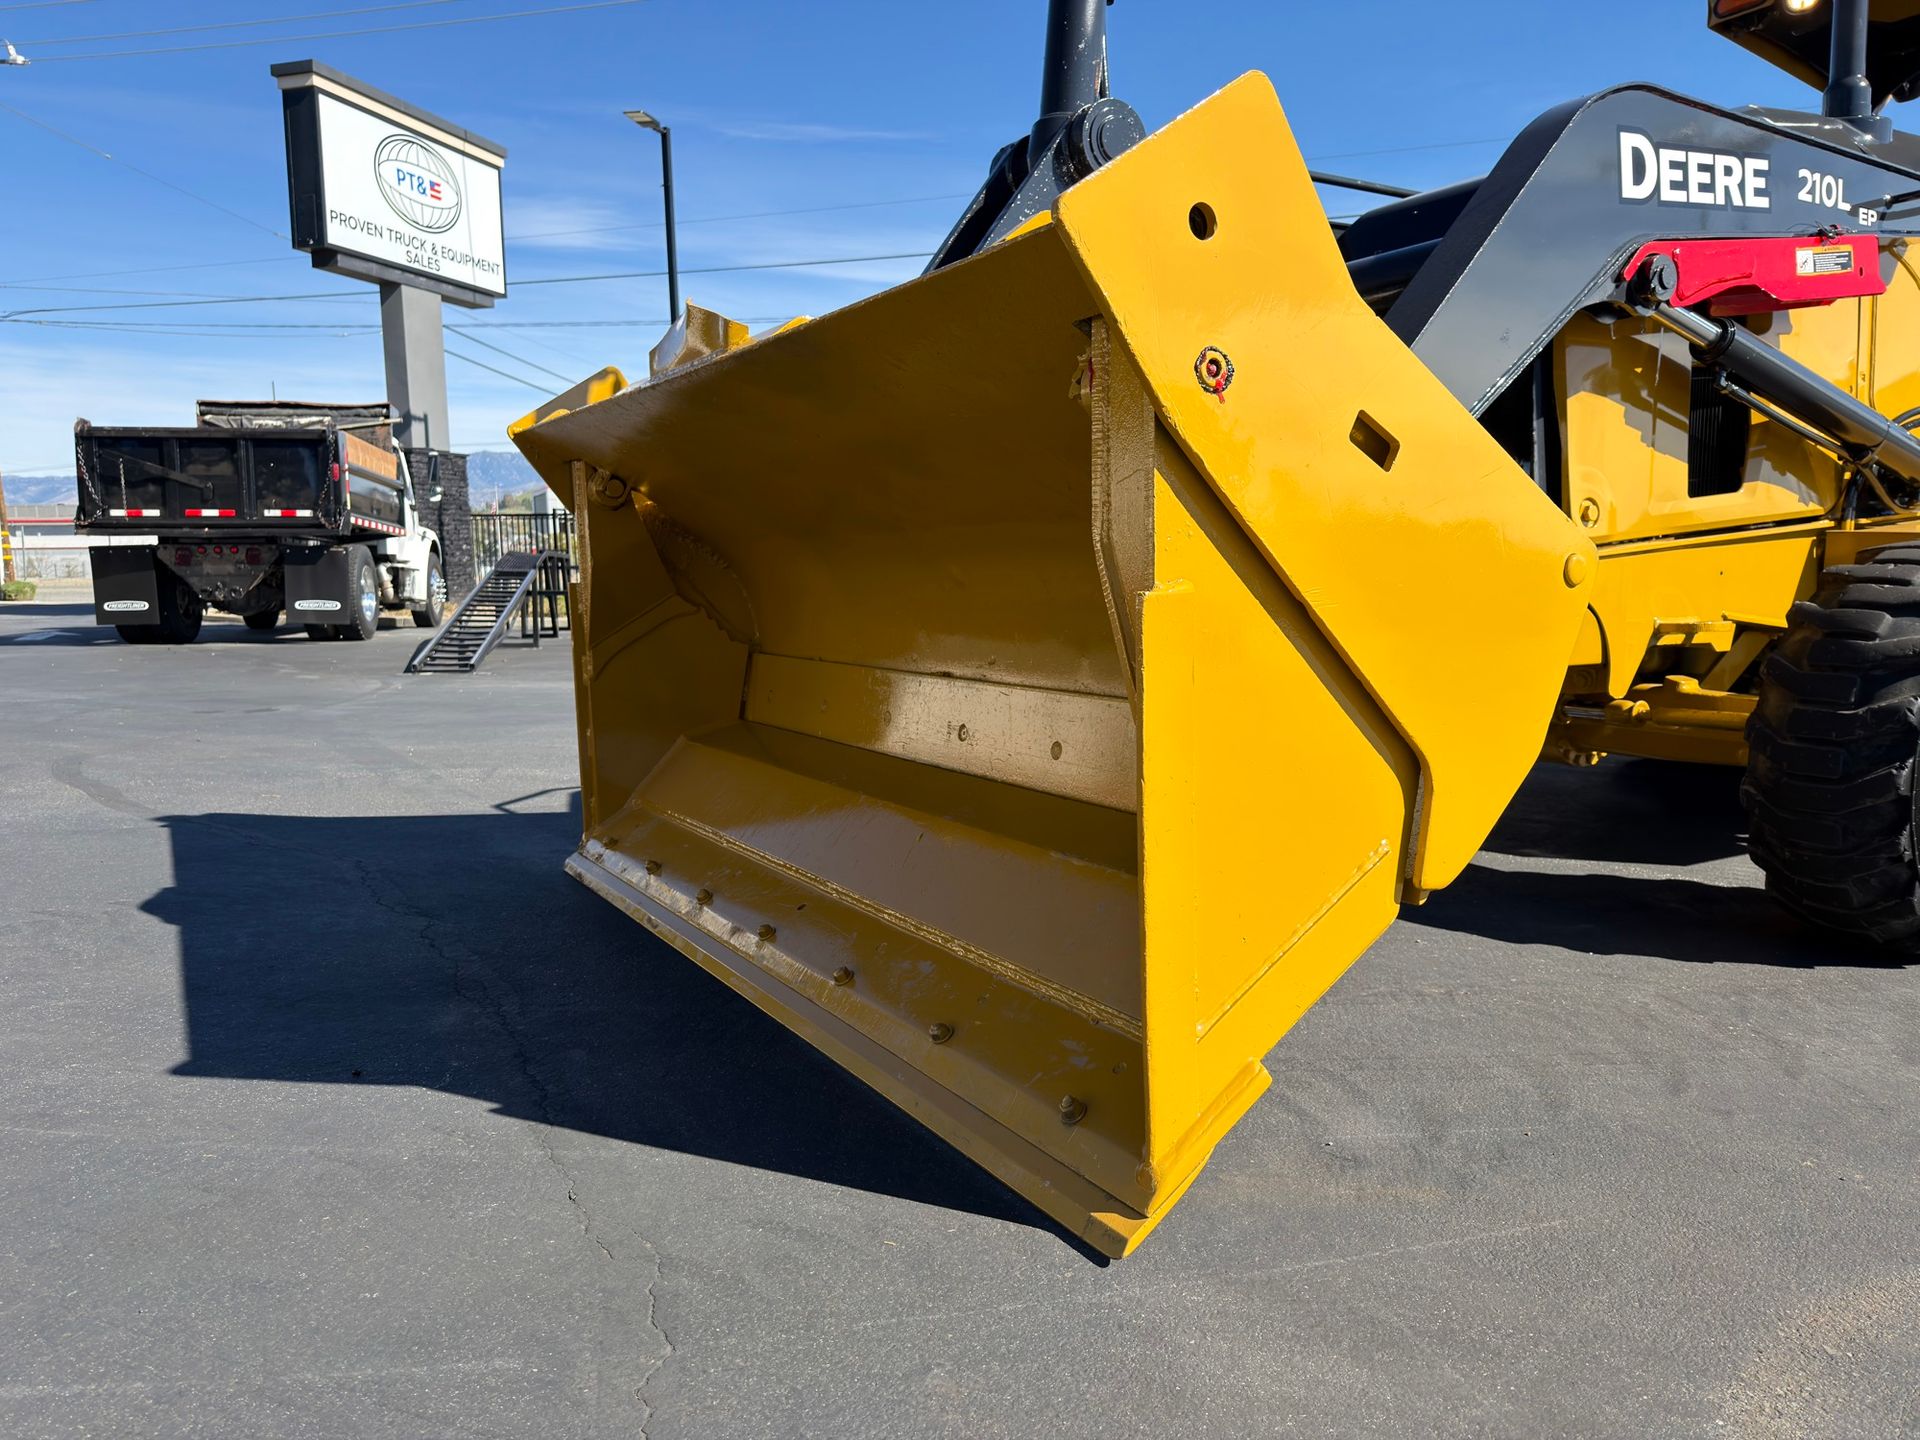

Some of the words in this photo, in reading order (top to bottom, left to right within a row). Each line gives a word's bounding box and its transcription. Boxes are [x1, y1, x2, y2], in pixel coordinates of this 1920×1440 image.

[1619, 131, 1770, 208] DEERE
[1797, 168, 1851, 211] 210L
[1858, 207, 1877, 226] EP
[329, 209, 384, 239] PROVEN
[386, 227, 428, 253] TRUCK
[431, 242, 439, 256] &
[441, 246, 500, 276] EQUIPMENT
[405, 250, 441, 272] SALES
